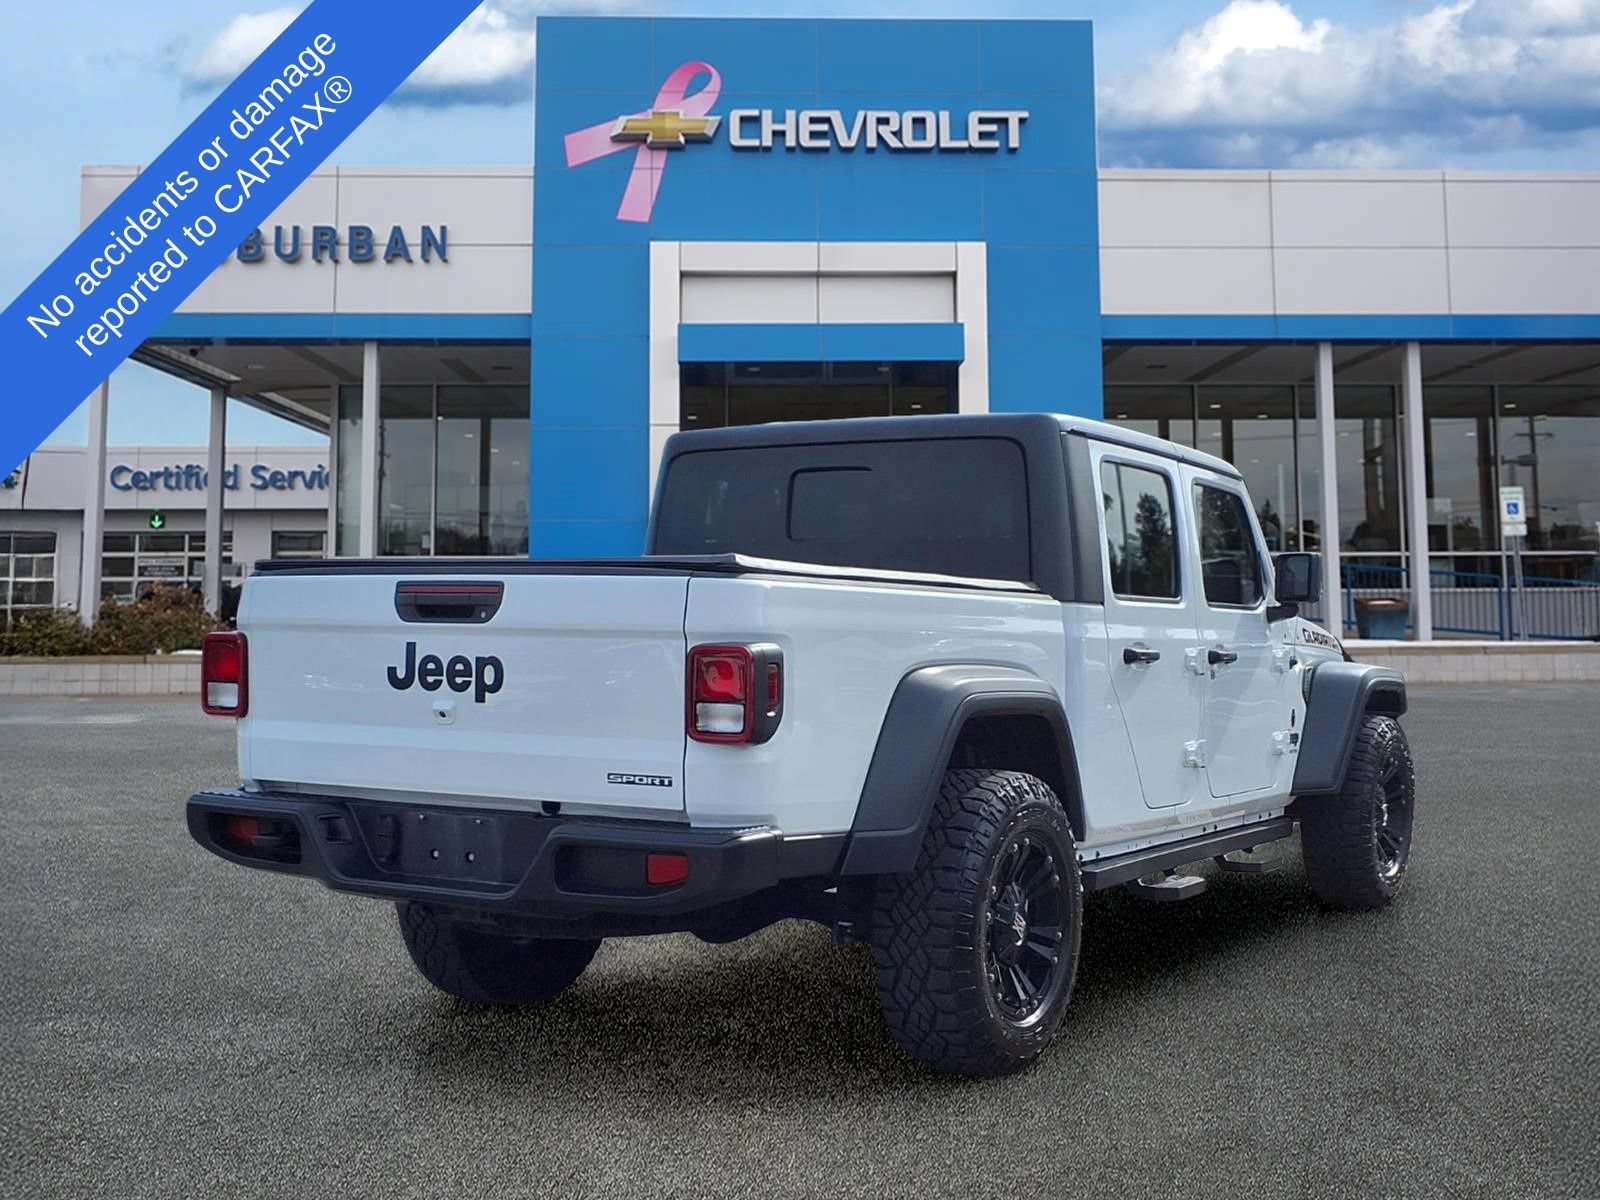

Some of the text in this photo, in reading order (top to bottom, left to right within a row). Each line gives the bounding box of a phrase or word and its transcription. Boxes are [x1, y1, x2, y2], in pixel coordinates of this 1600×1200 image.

[728, 108, 1030, 150] CHEVROLET
[234, 225, 449, 264] BURBAN
[110, 465, 330, 491] Certifid Servi
[387, 641, 504, 703] Jeep
[608, 773, 673, 787] SPORT
